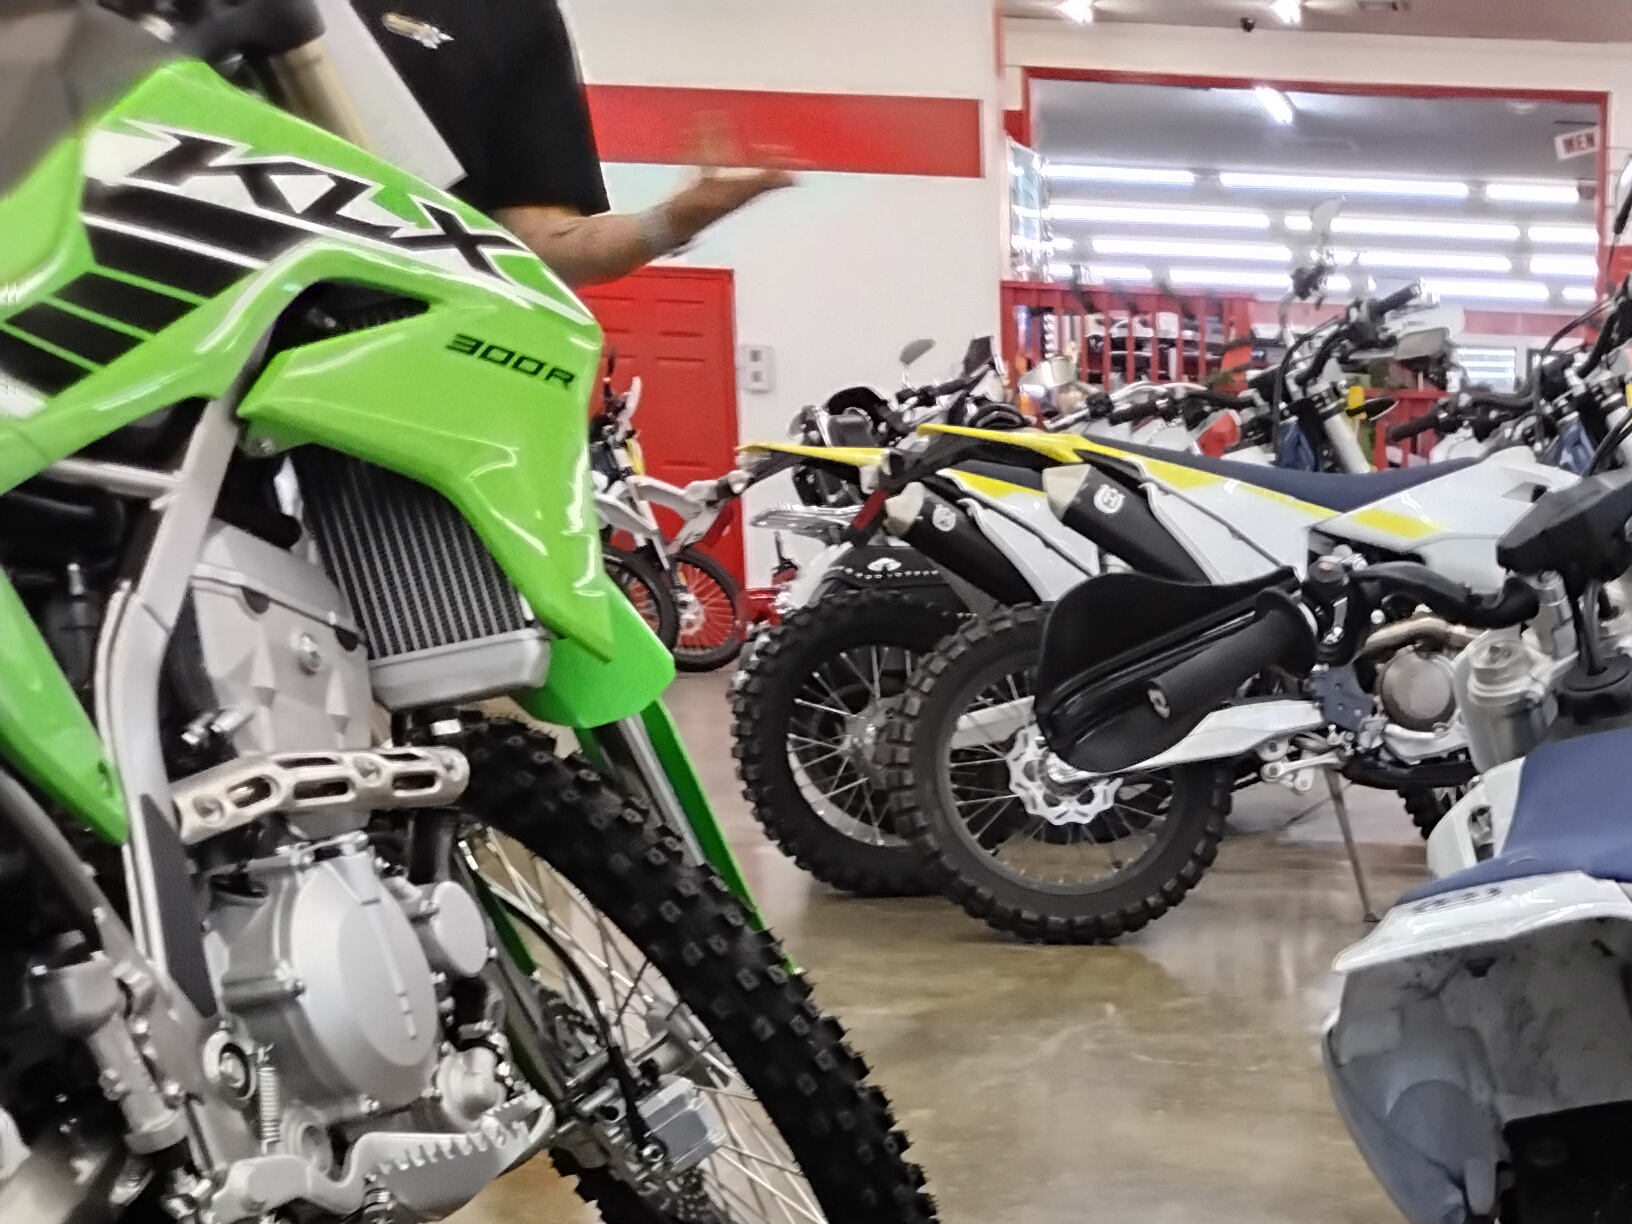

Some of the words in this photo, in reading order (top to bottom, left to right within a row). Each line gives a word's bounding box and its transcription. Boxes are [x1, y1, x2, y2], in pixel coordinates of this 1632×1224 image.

[1562, 132, 1596, 155] MEN
[128, 132, 528, 282] KLX
[445, 333, 576, 390] 300R
